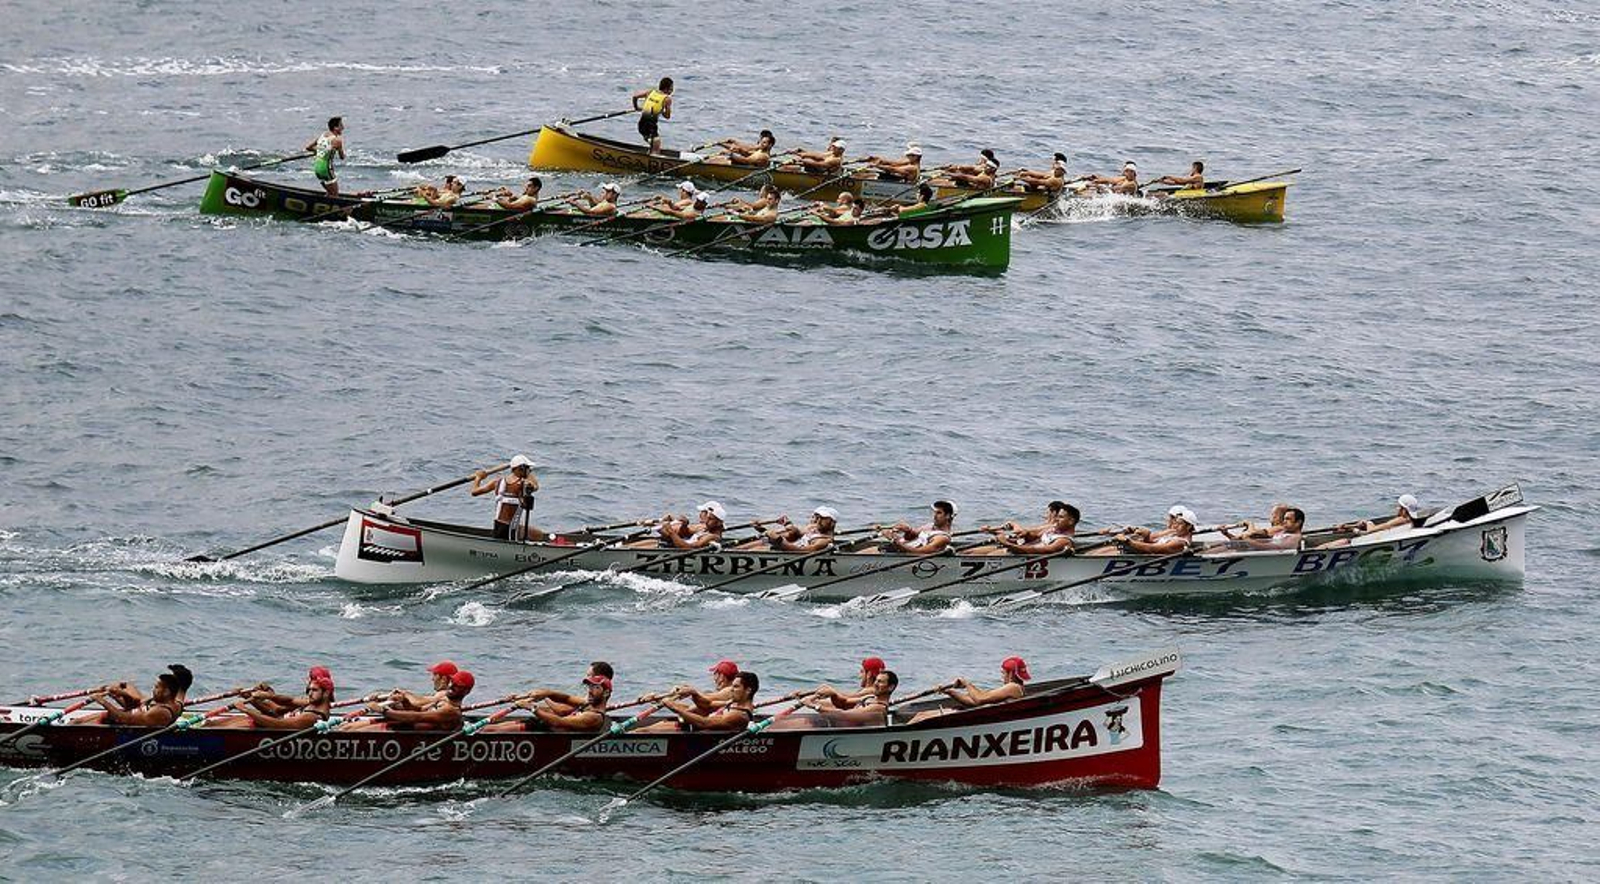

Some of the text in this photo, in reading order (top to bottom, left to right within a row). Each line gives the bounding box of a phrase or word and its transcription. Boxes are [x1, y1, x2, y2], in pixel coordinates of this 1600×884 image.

[80, 193, 114, 208] GO fit
[258, 737, 400, 760] CONCELLO
[452, 740, 535, 762] BOIRO
[584, 742, 661, 754] ABANCA
[880, 719, 1098, 763] RIANXEIRA
